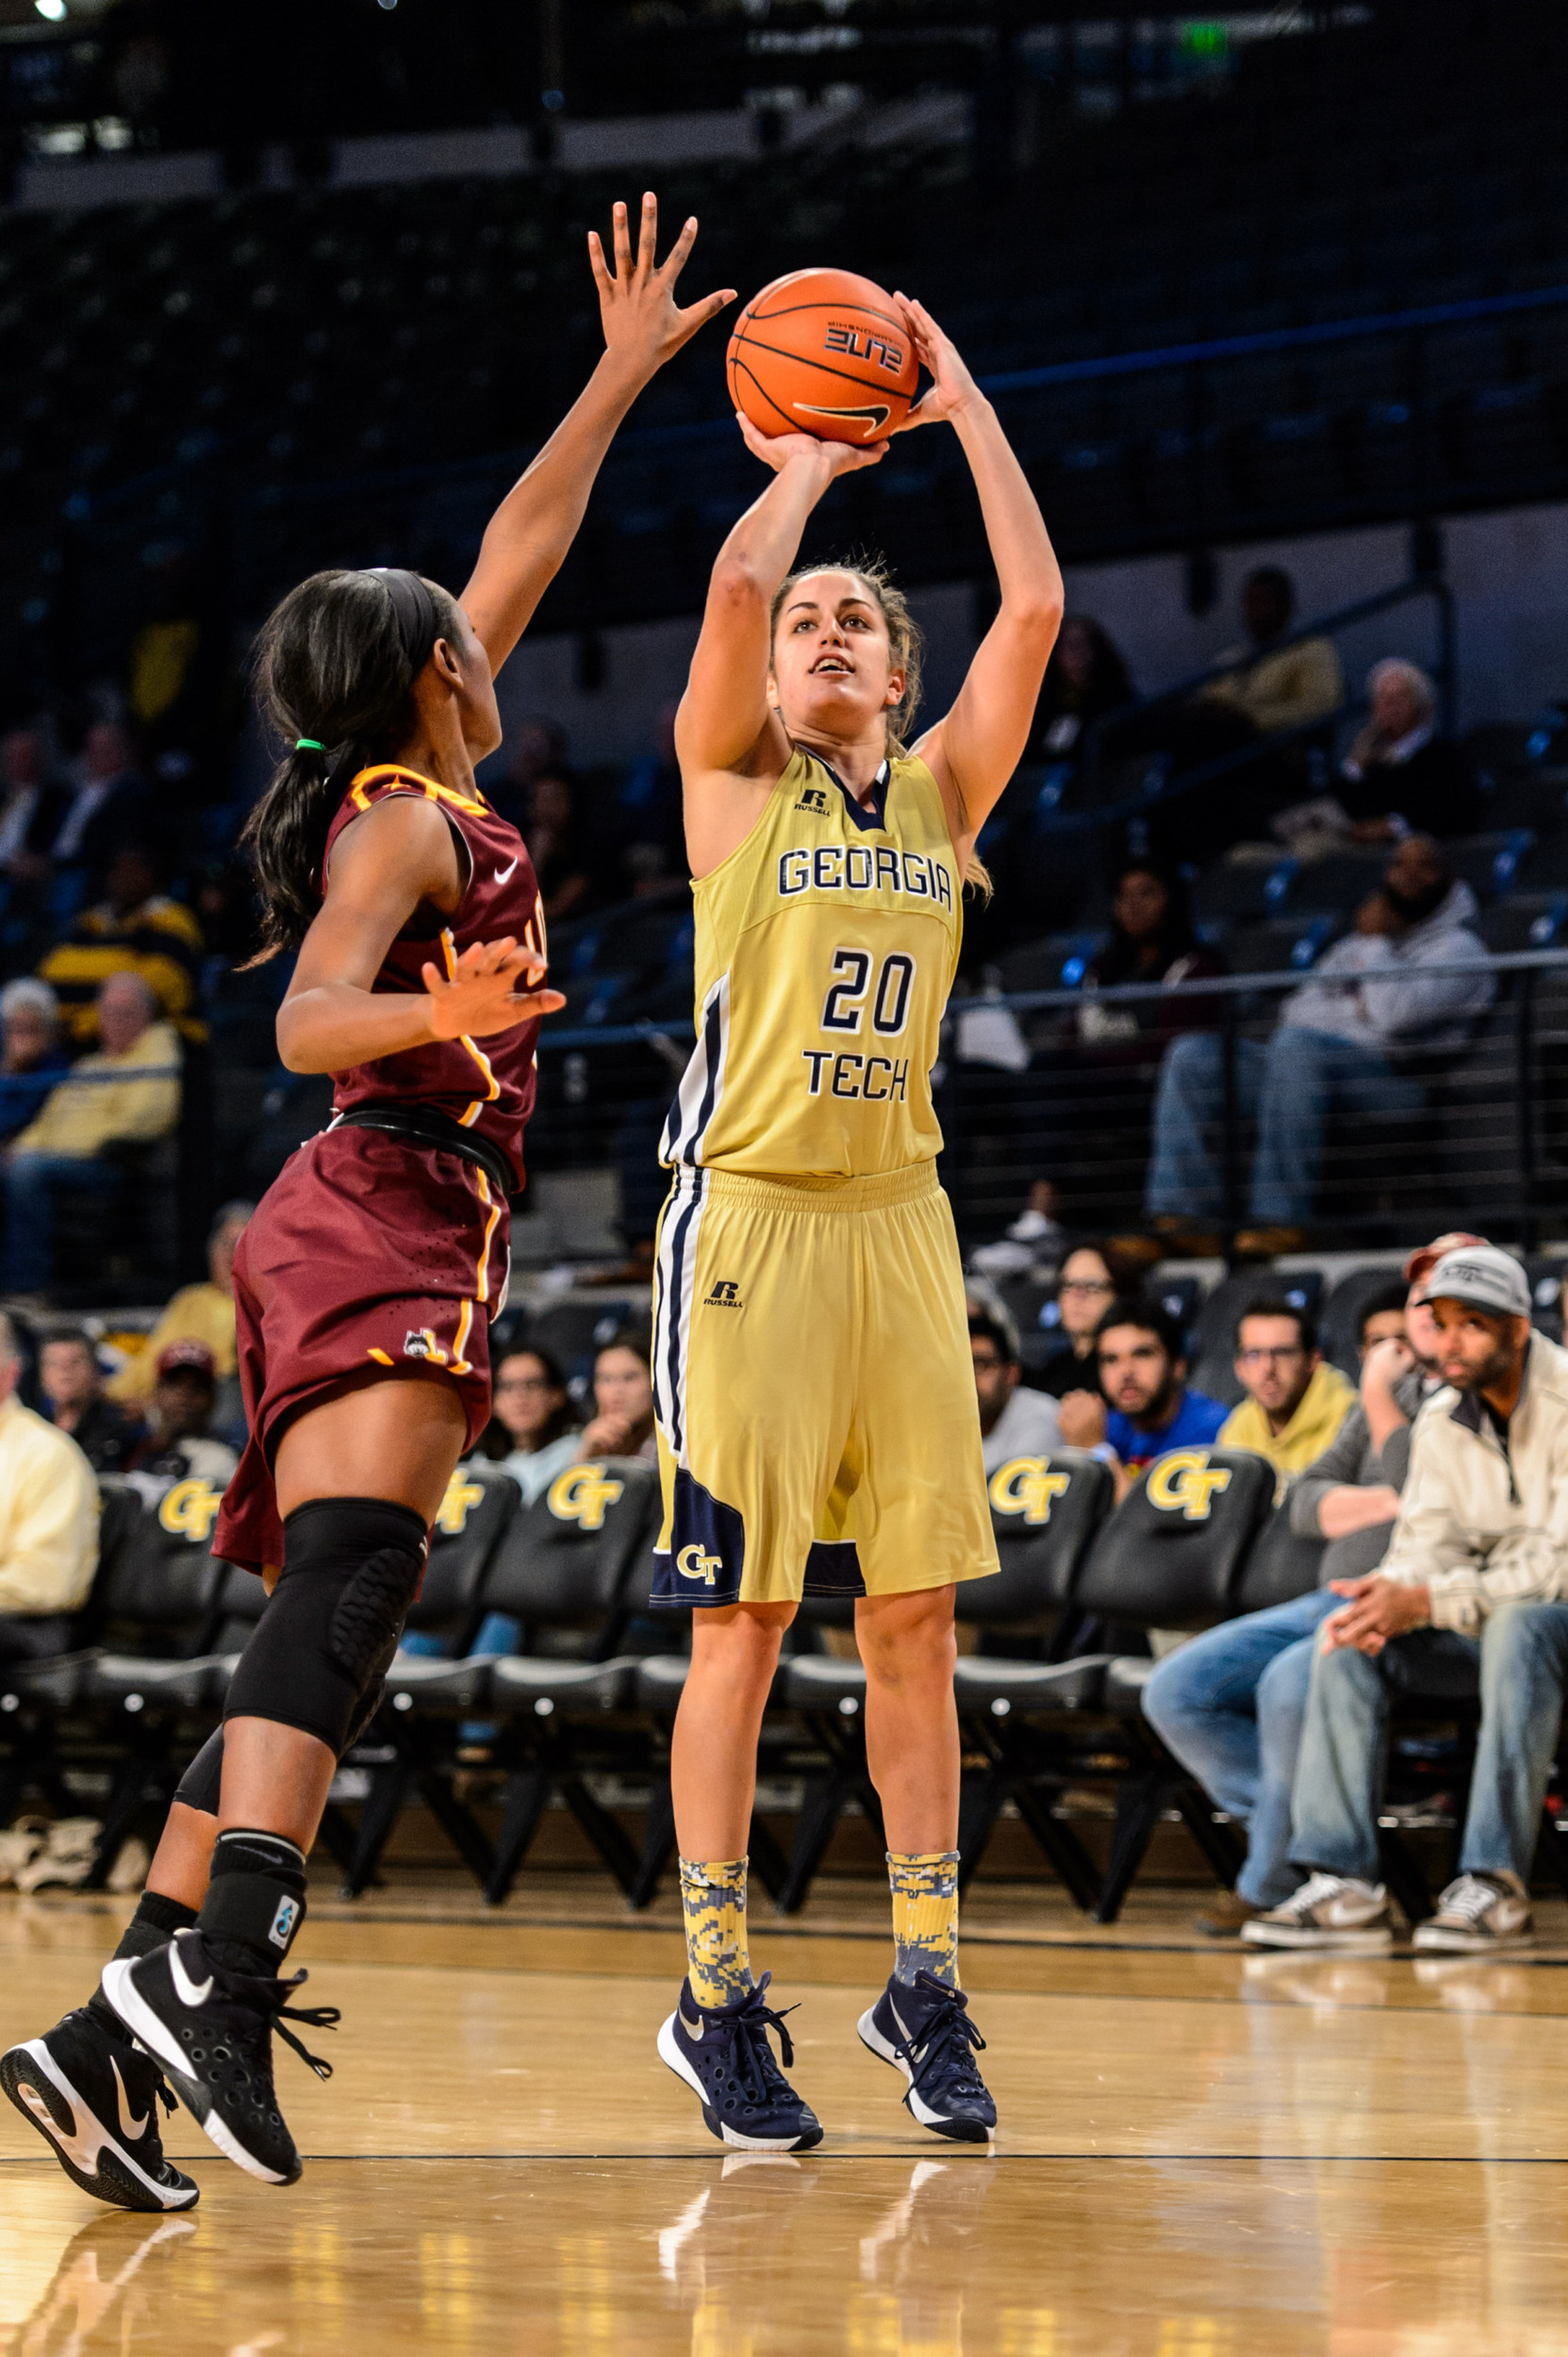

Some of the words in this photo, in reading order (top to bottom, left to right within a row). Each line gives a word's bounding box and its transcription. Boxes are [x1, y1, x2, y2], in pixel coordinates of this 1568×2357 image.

[824, 327, 902, 375] ELITE
[828, 321, 904, 350] AMPIONSHIP
[794, 803, 831, 817] RUSSELL
[778, 845, 952, 915] GEORGIA
[819, 945, 916, 1037] 20
[801, 1048, 909, 1103] TECH
[703, 1298, 743, 1308] RUSSELL
[547, 1463, 625, 1530] GT
[988, 1455, 1071, 1525] GT
[1146, 1451, 1232, 1521] GT
[677, 1543, 722, 1585] GT
